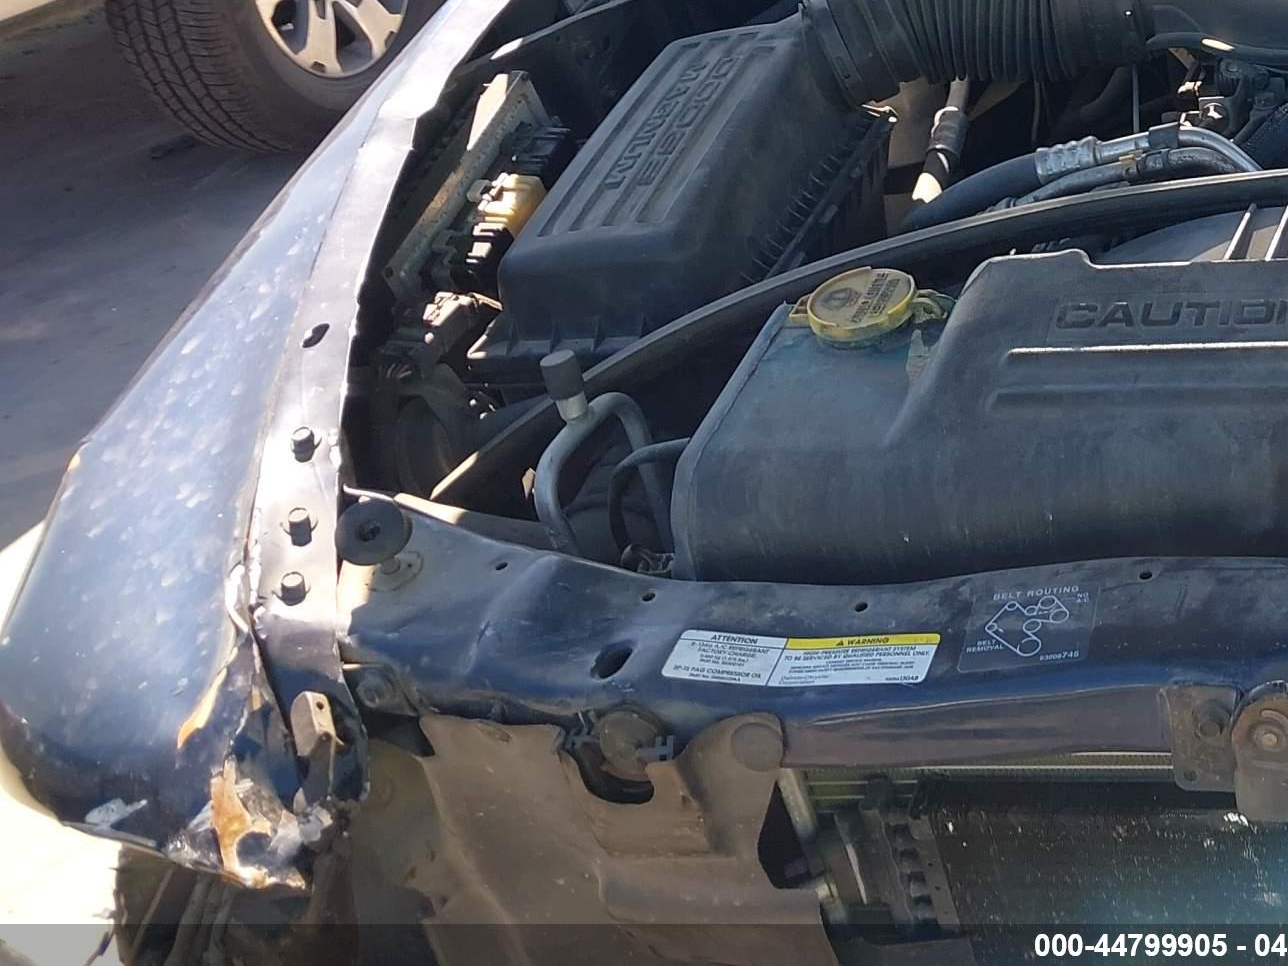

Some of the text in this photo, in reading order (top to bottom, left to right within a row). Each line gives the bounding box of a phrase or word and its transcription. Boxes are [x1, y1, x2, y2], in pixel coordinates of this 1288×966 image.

[993, 585, 1080, 602] BELT ROUTING
[710, 633, 759, 645] ATTENTION
[847, 636, 890, 645] WARNING
[966, 645, 1004, 654] REMOVAL
